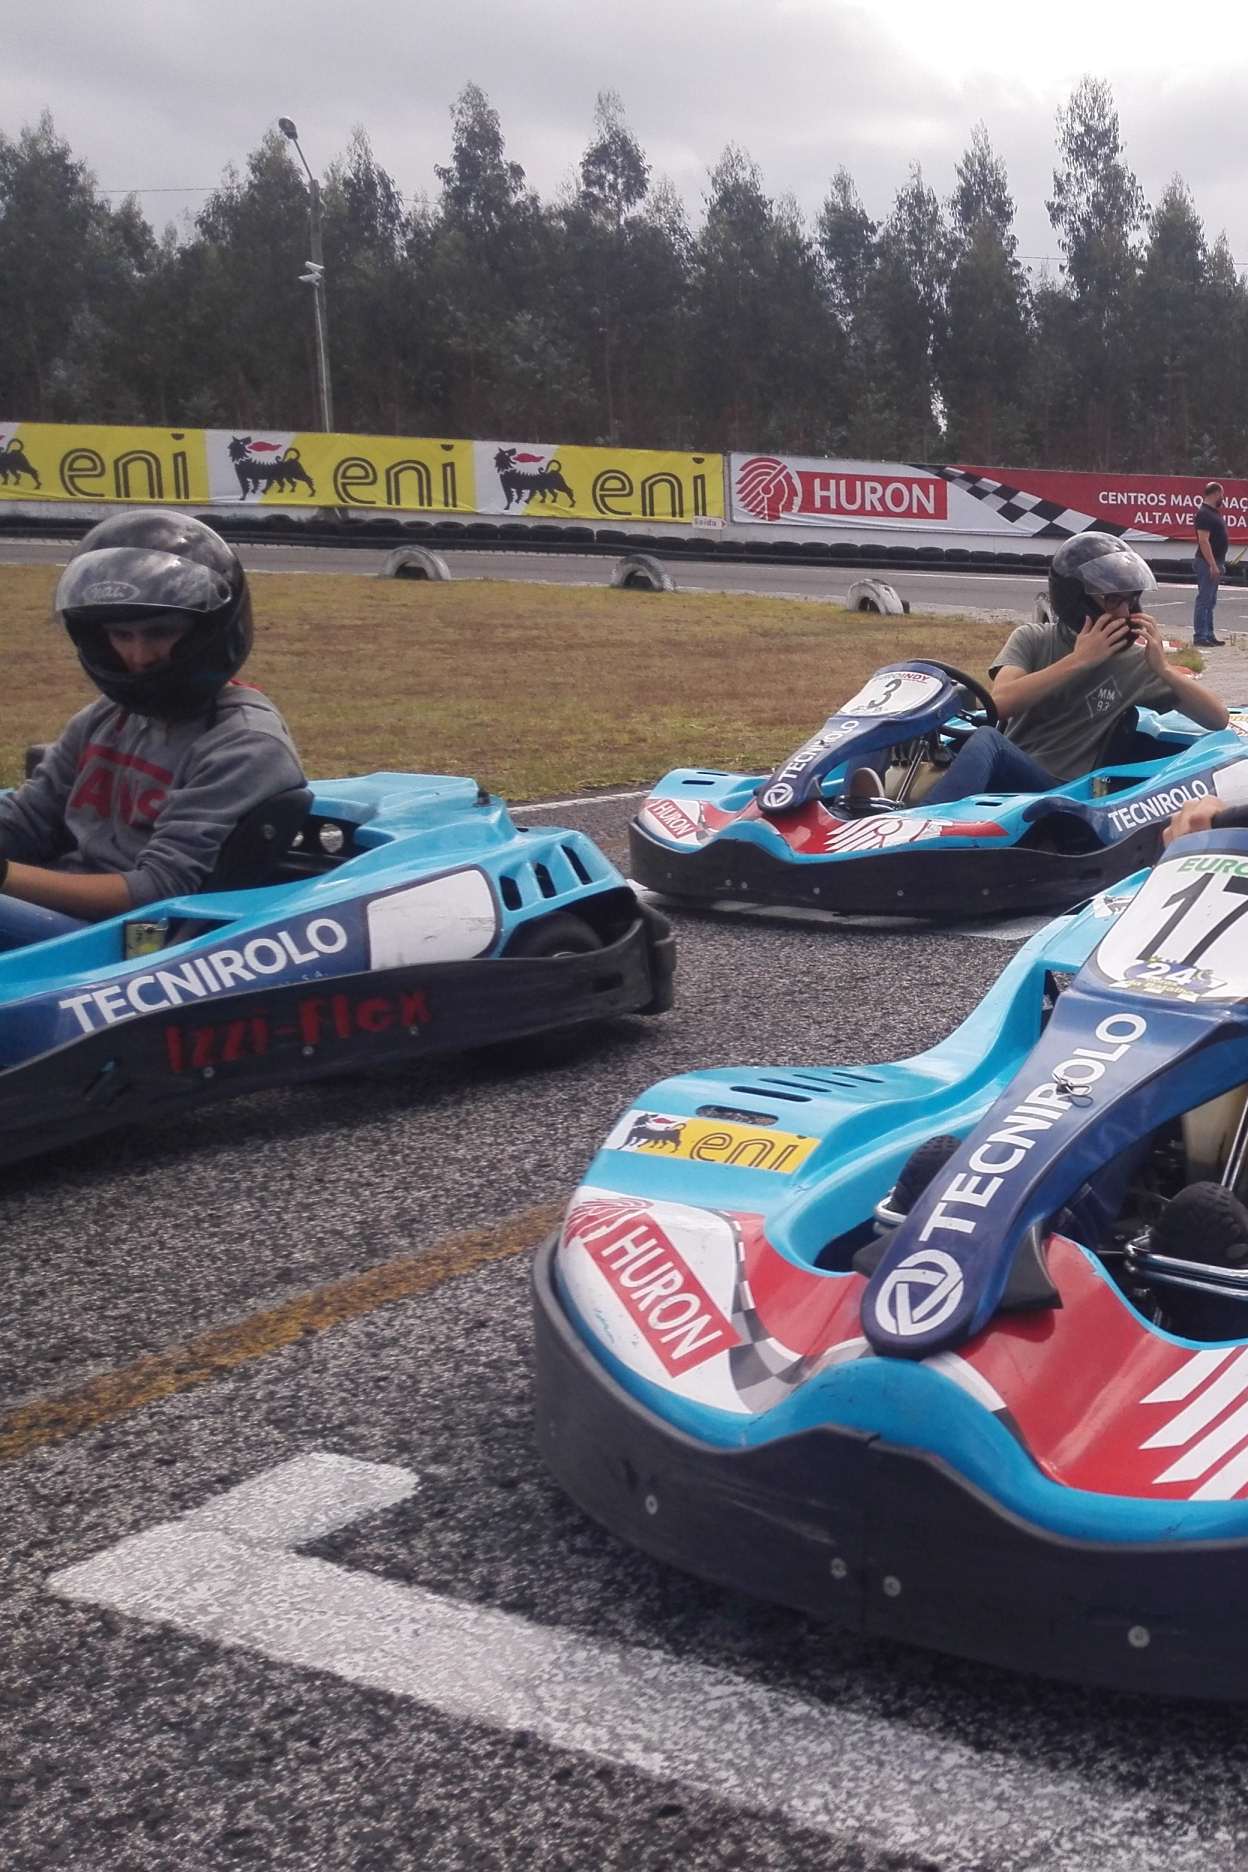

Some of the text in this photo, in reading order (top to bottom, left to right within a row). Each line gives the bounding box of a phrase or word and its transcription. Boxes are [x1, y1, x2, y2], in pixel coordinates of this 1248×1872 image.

[59, 432, 190, 500] eni
[333, 444, 458, 508] eni
[592, 457, 707, 517] eni
[813, 478, 935, 514] HURON
[1098, 491, 1167, 506] CENTROS
[1134, 511, 1173, 525] ALTA
[867, 678, 902, 709] 3
[653, 800, 695, 837] HURON
[1107, 778, 1209, 833] TECNIROLO
[58, 917, 348, 1035] TECNIROLO
[1135, 962, 1200, 986] 24
[689, 1131, 809, 1171] eni
[918, 1013, 1148, 1242] TECNIROLO
[601, 1224, 723, 1361] HURON
